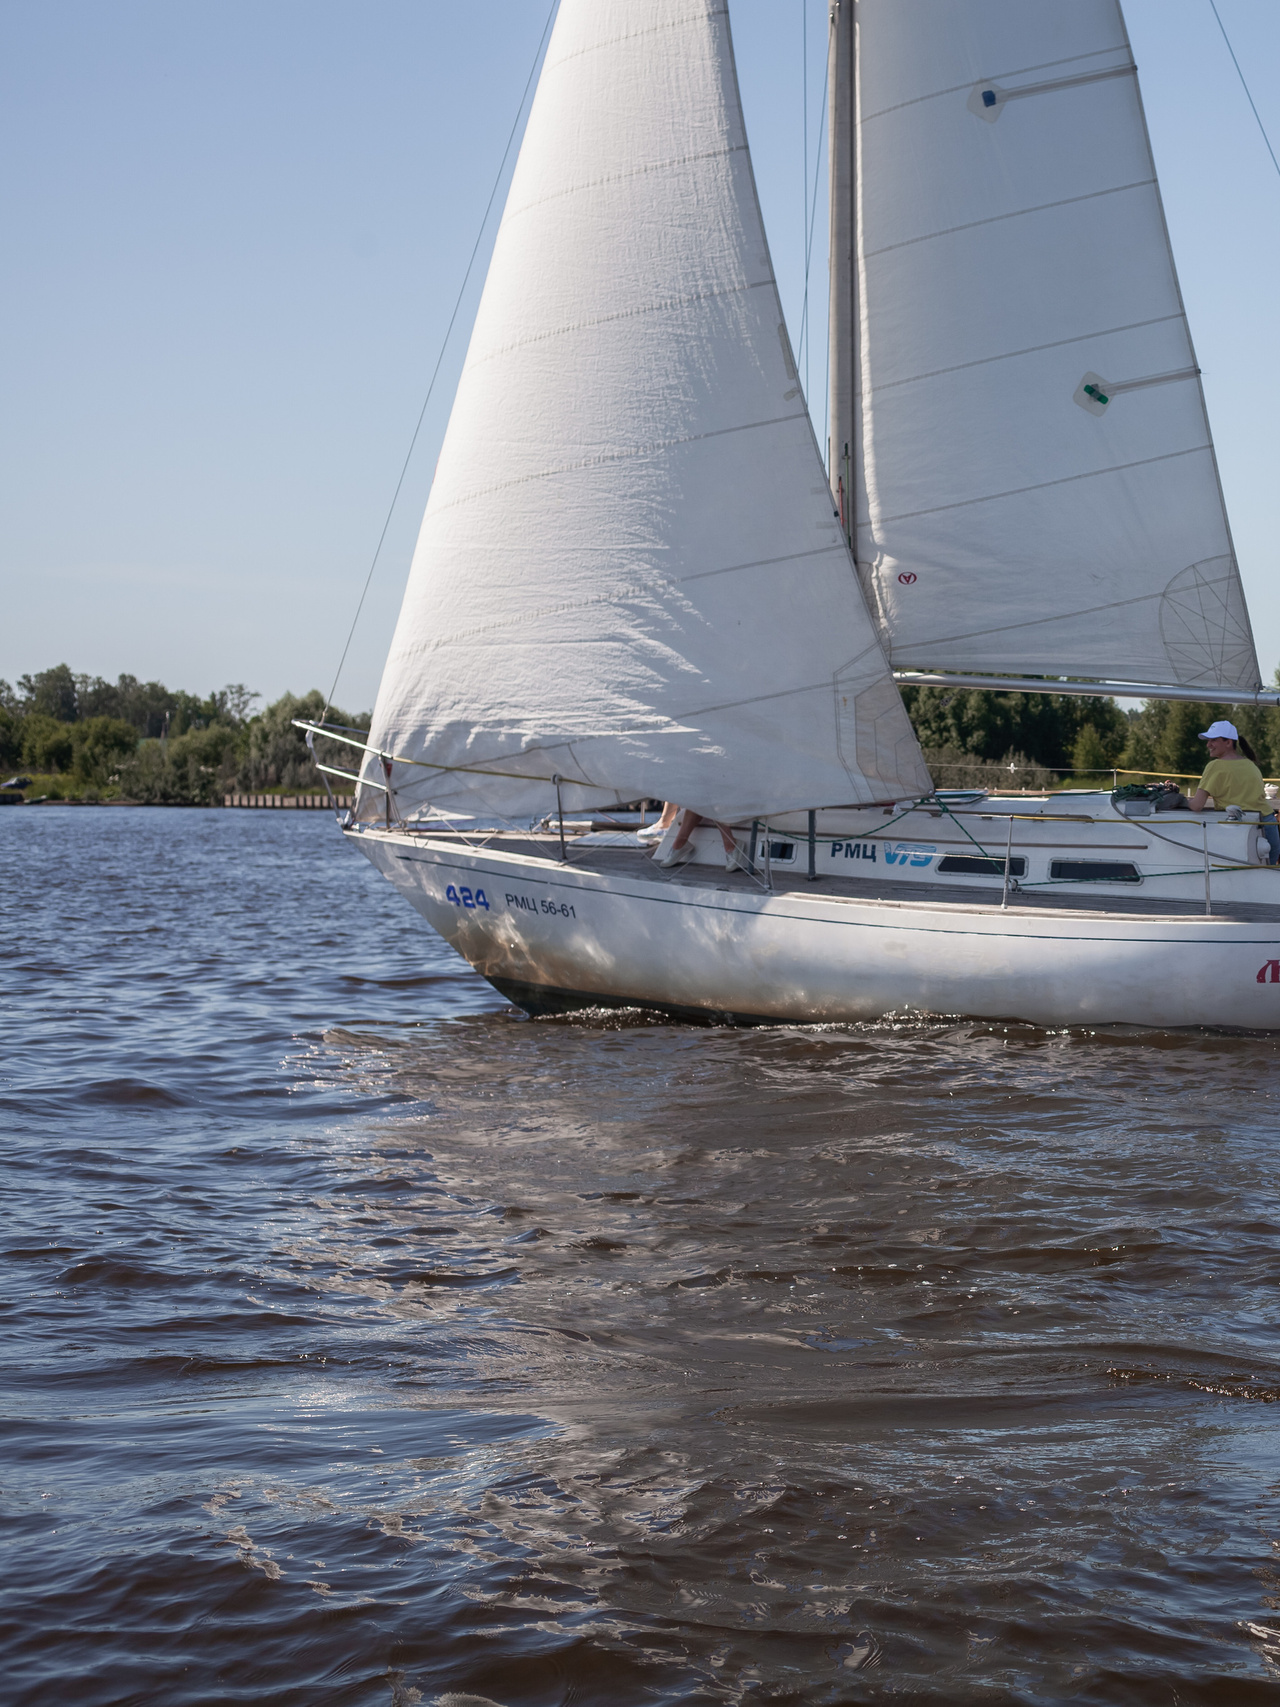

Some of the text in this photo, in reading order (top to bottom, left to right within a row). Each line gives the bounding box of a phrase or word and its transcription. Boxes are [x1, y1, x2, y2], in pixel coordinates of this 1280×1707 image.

[830, 841, 877, 863] РМЦ
[446, 884, 490, 912] 424
[505, 893, 577, 919] РМЦ 56-61
